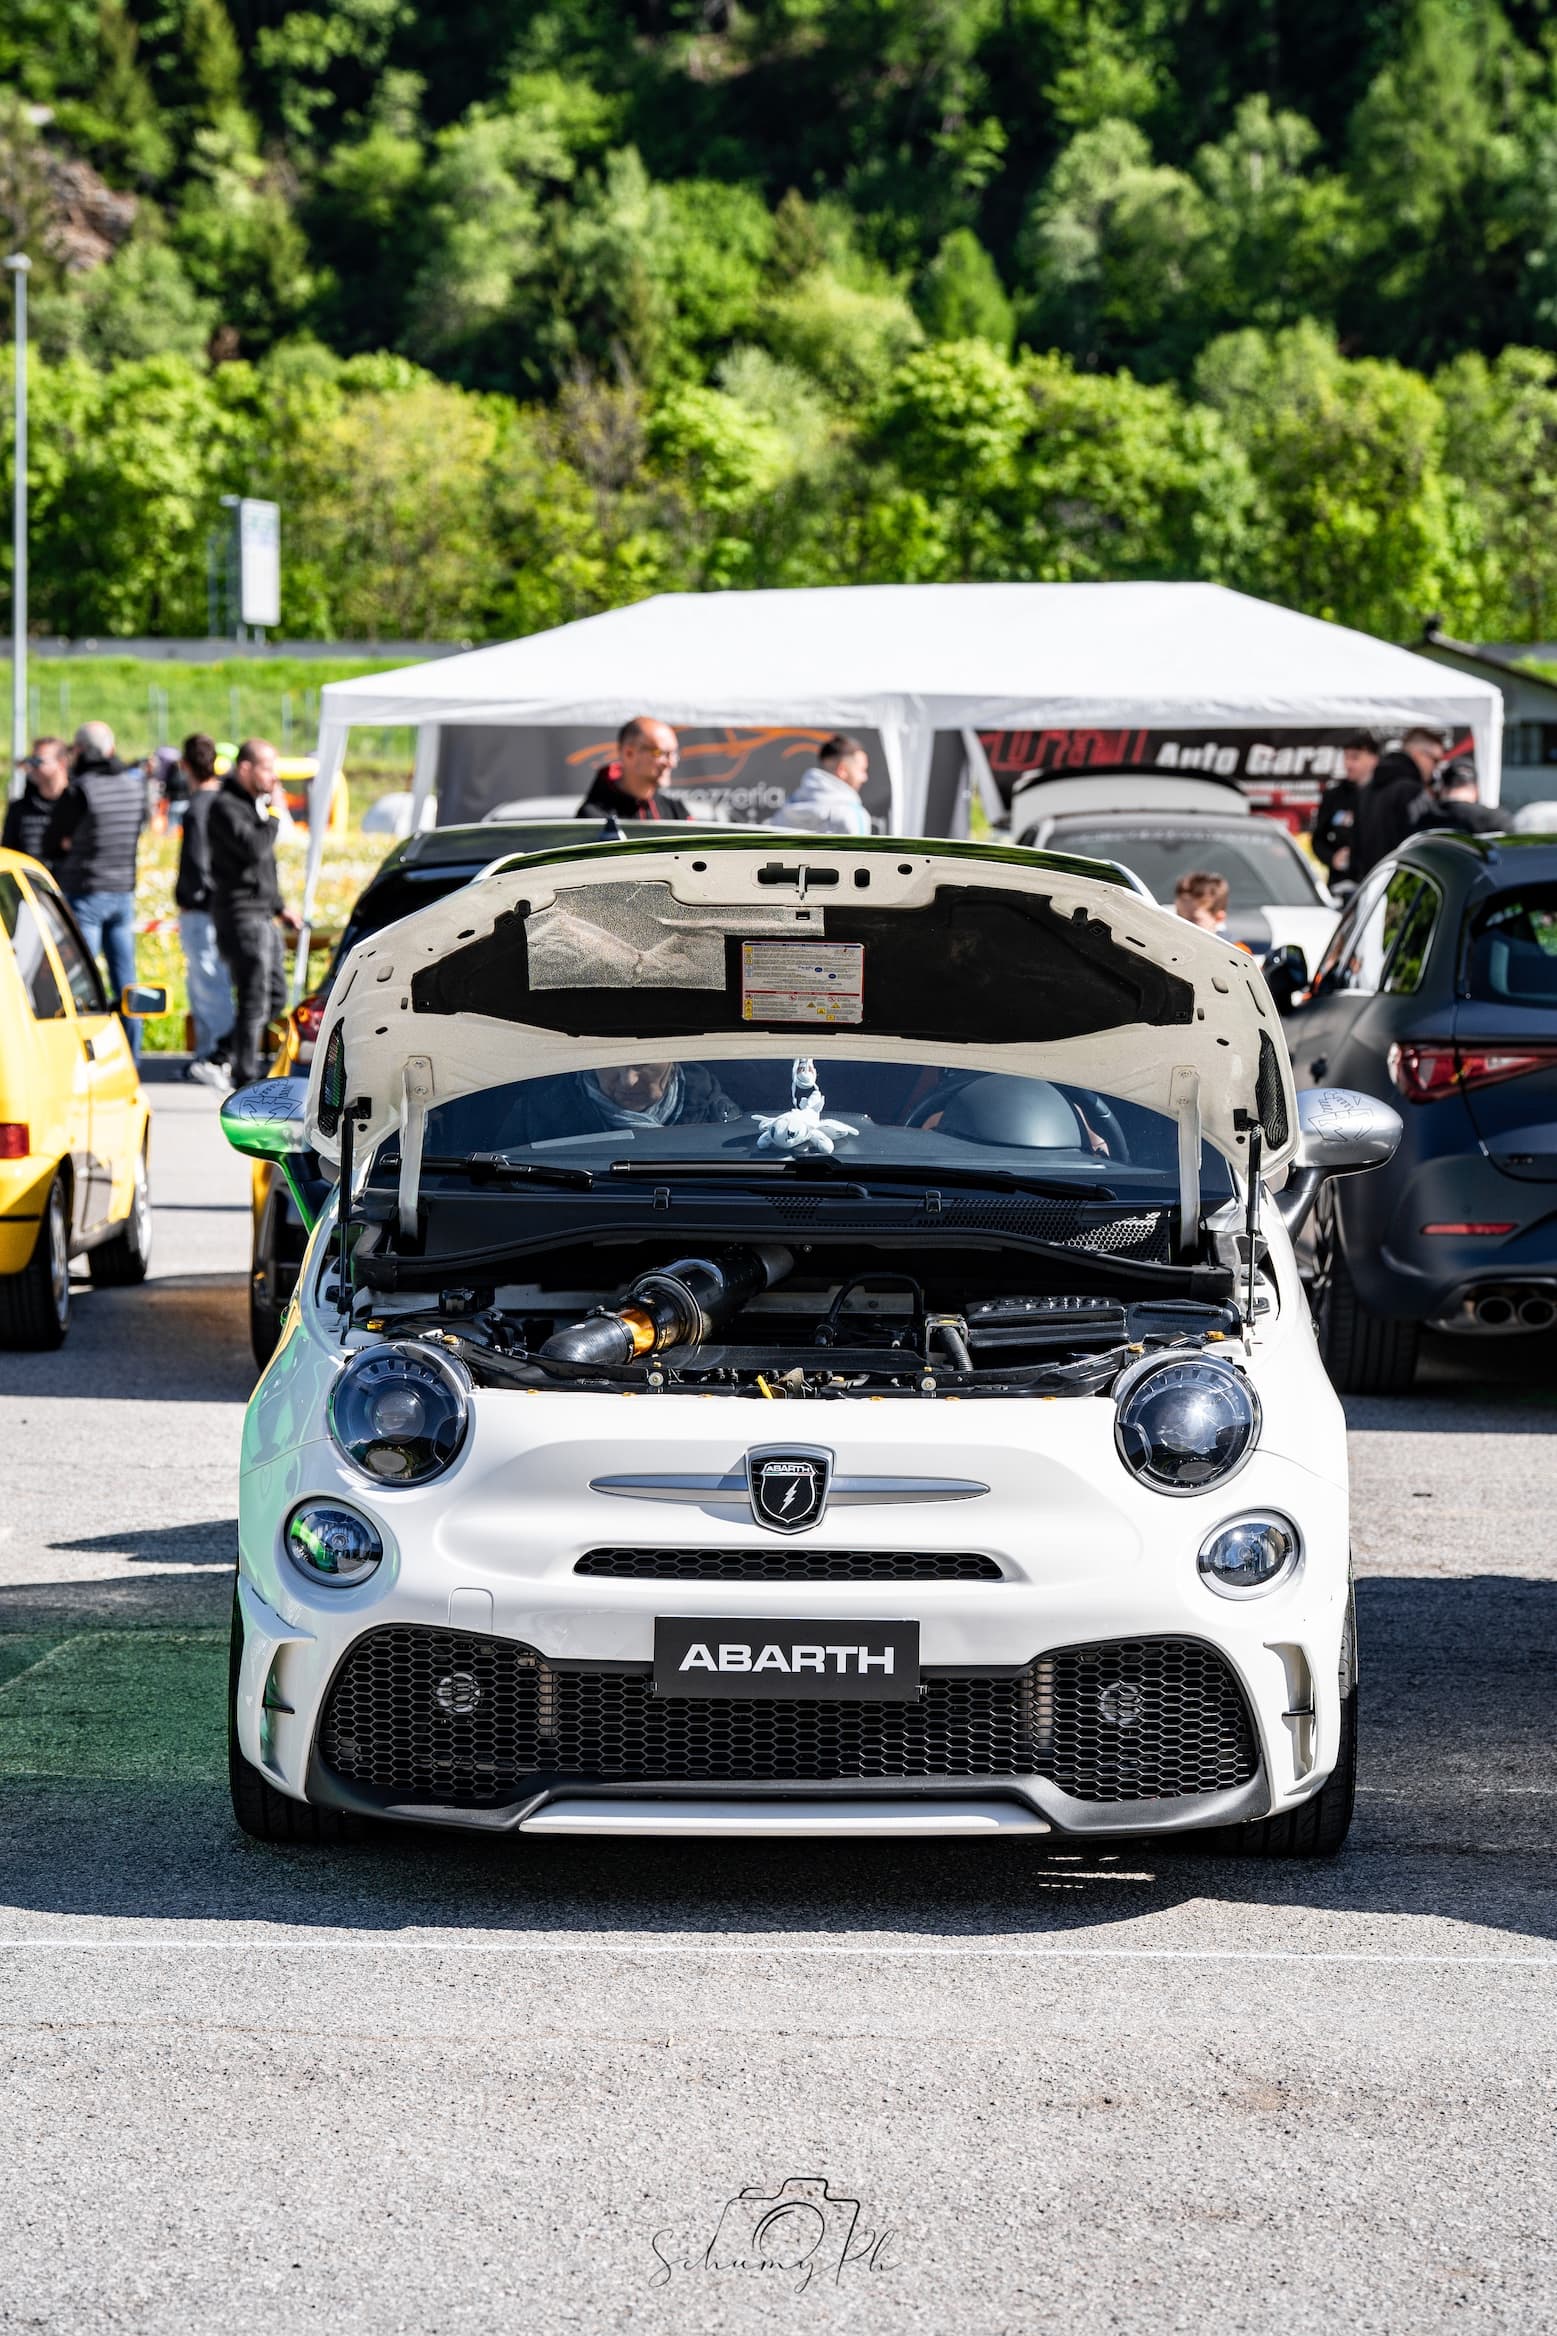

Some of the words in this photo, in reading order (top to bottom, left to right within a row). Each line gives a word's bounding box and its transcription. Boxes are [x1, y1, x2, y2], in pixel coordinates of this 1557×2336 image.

[1155, 742, 1240, 776] Auto
[1245, 743, 1348, 780] Garag
[766, 1464, 810, 1473] ABARTH
[678, 1643, 895, 1675] ABARTH
